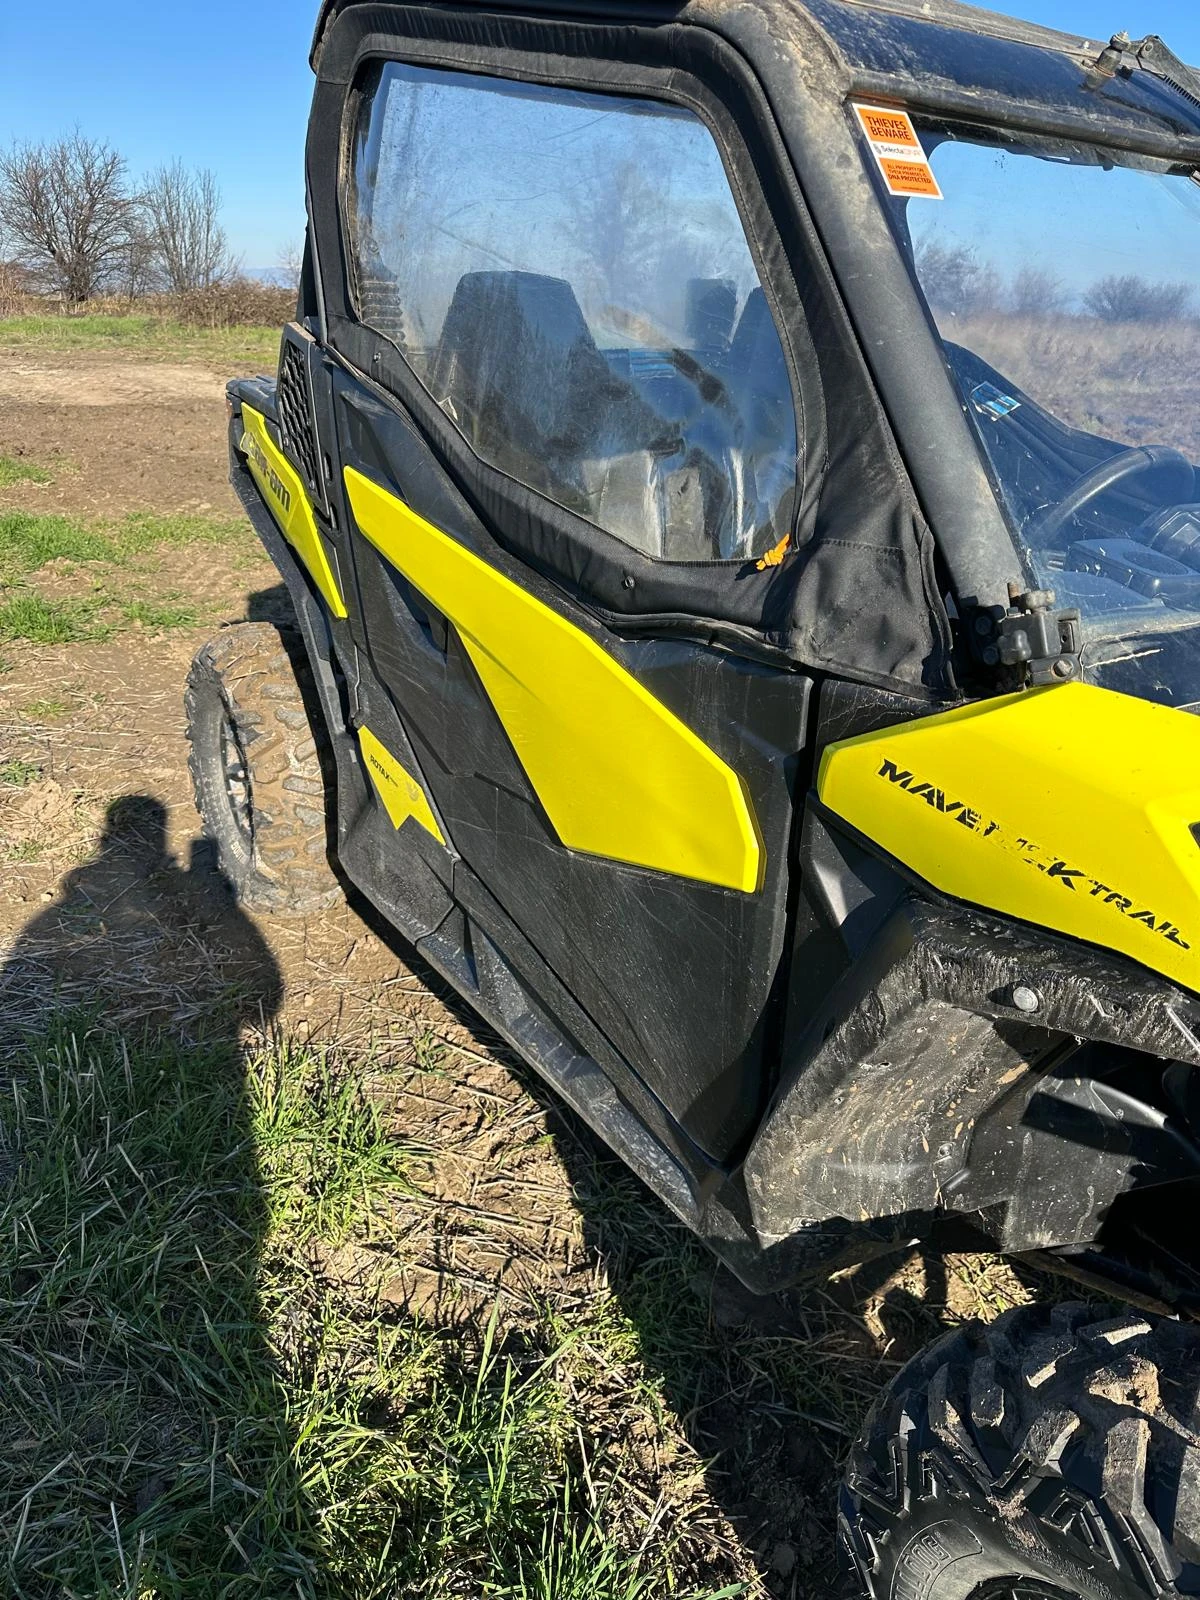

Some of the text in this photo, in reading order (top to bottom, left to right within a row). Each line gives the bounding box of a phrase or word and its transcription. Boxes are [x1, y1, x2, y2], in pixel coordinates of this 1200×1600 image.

[866, 116, 907, 130] THIEVES
[870, 126, 911, 141] BEWARE
[370, 754, 390, 783] ROTAX
[1087, 879, 1191, 950] TRAIL
